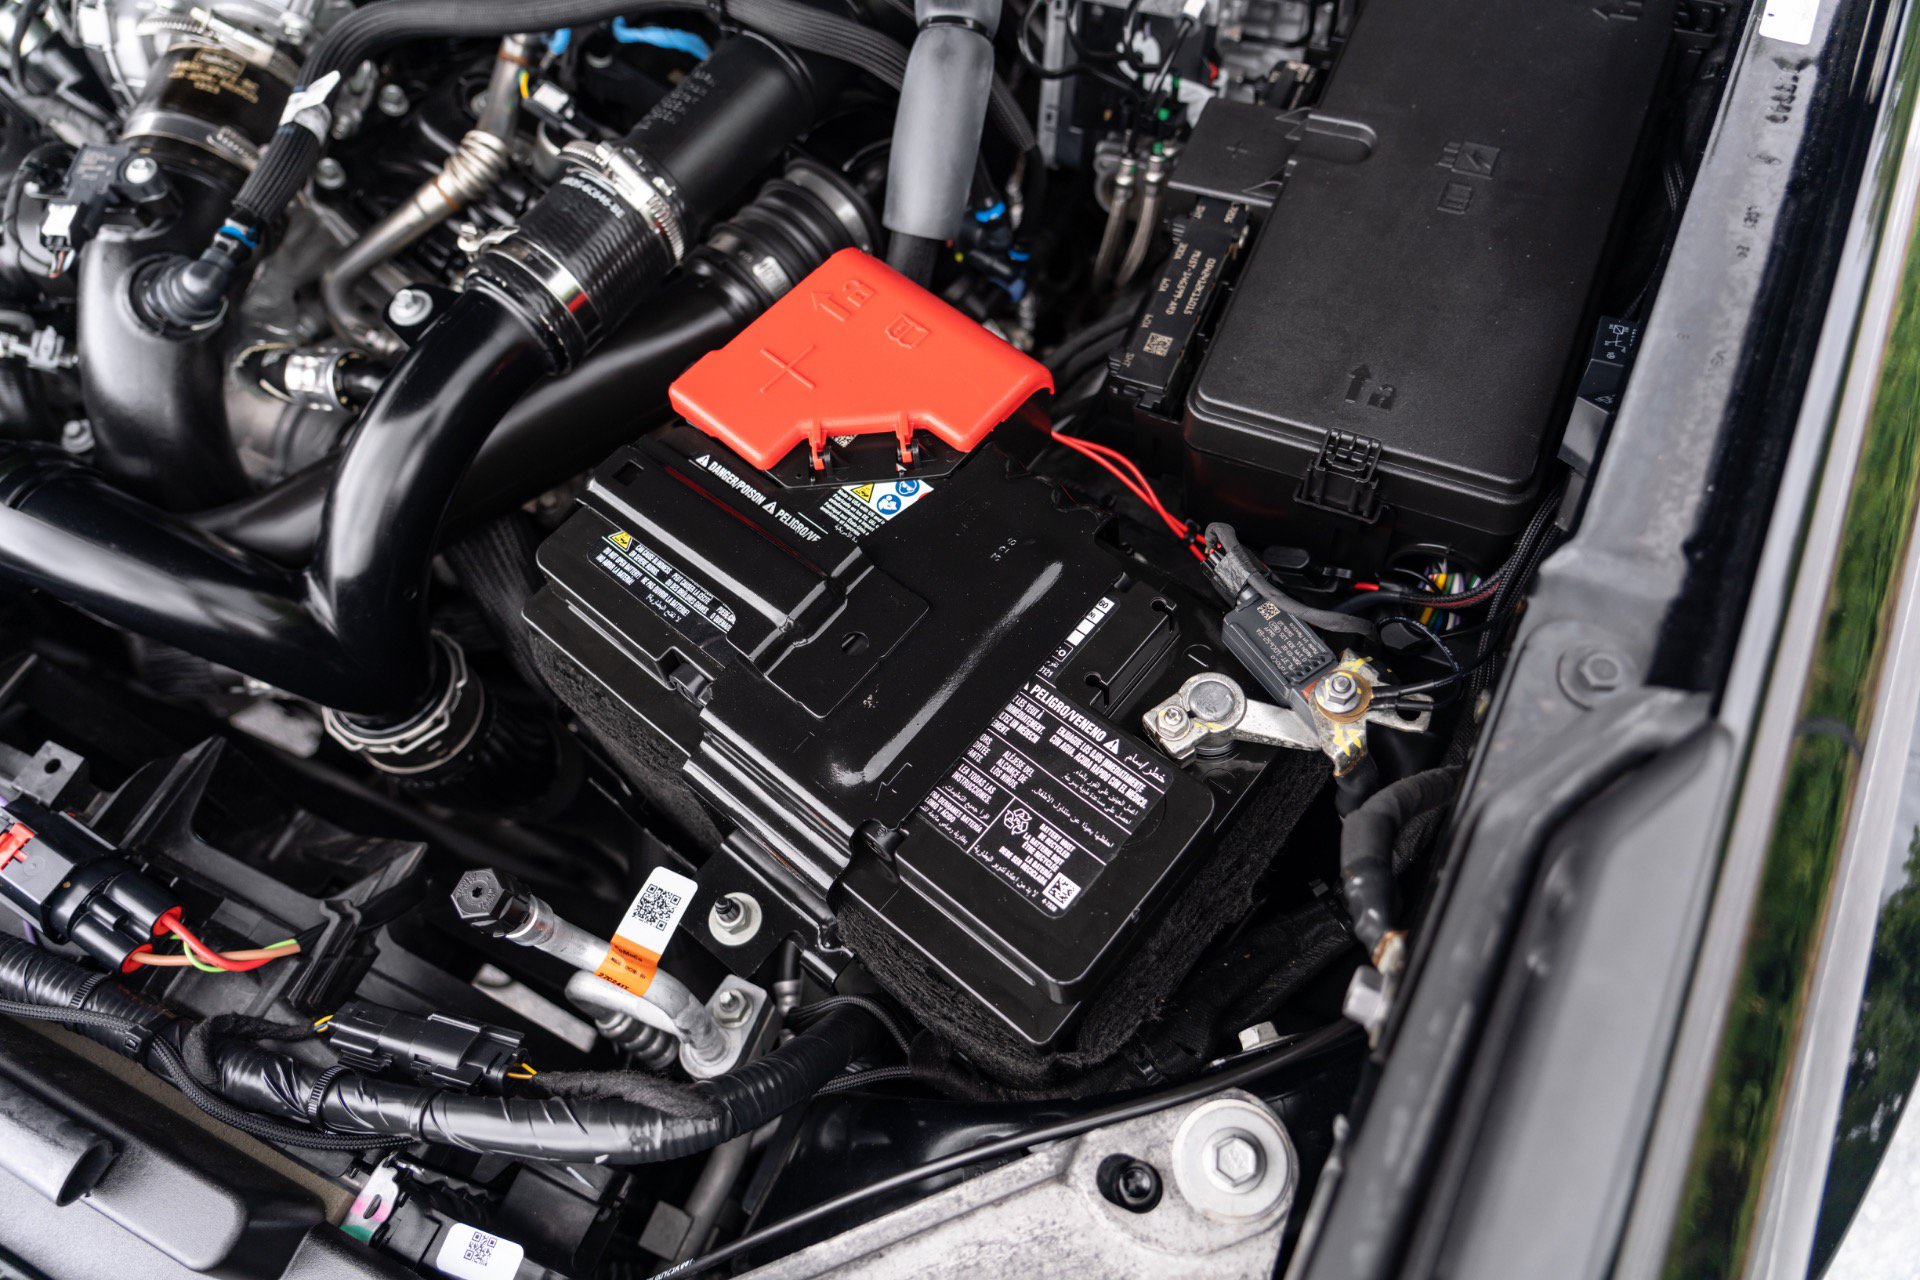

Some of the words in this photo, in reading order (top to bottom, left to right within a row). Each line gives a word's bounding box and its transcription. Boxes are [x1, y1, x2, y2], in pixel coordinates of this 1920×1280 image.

[707, 461, 766, 508] DANGER/POISON
[851, 499, 861, 507] USA
[1015, 697, 1028, 709] LES
[1024, 703, 1040, 717] YEUX
[1029, 684, 1107, 742] PELIGRO/VENENO
[1002, 750, 1026, 770] ALÉJESE
[1022, 765, 1035, 778] DEL
[1049, 734, 1063, 747] CON
[1058, 742, 1076, 757] AGUA.
[1073, 752, 1094, 769] ACUDA
[1108, 776, 1122, 789] CON
[1118, 783, 1128, 794] EL
[1079, 742, 1093, 755] LOS
[1089, 749, 1105, 764] OJOS
[958, 763, 971, 775] LEA
[968, 770, 987, 787] TODAS
[983, 782, 997, 795] LAS
[989, 765, 1003, 777] LOS
[996, 758, 1021, 779] ALCANCE
[1017, 773, 1028, 784] DE
[951, 771, 992, 805] INSTRUCCIONES.
[1022, 832, 1032, 842] LA
[1027, 837, 1054, 858] BATTERIE
[1050, 853, 1065, 866] DOIT
[1037, 832, 1047, 841] BE
[1044, 837, 1071, 859] RECYCLED
[1039, 823, 1062, 842] BATTERY
[1059, 838, 1076, 852] MUST
[998, 846, 1014, 859] DEBE
[1010, 855, 1023, 867] SER
[1020, 862, 1050, 886] RECICLADA
[1024, 855, 1034, 865] LA
